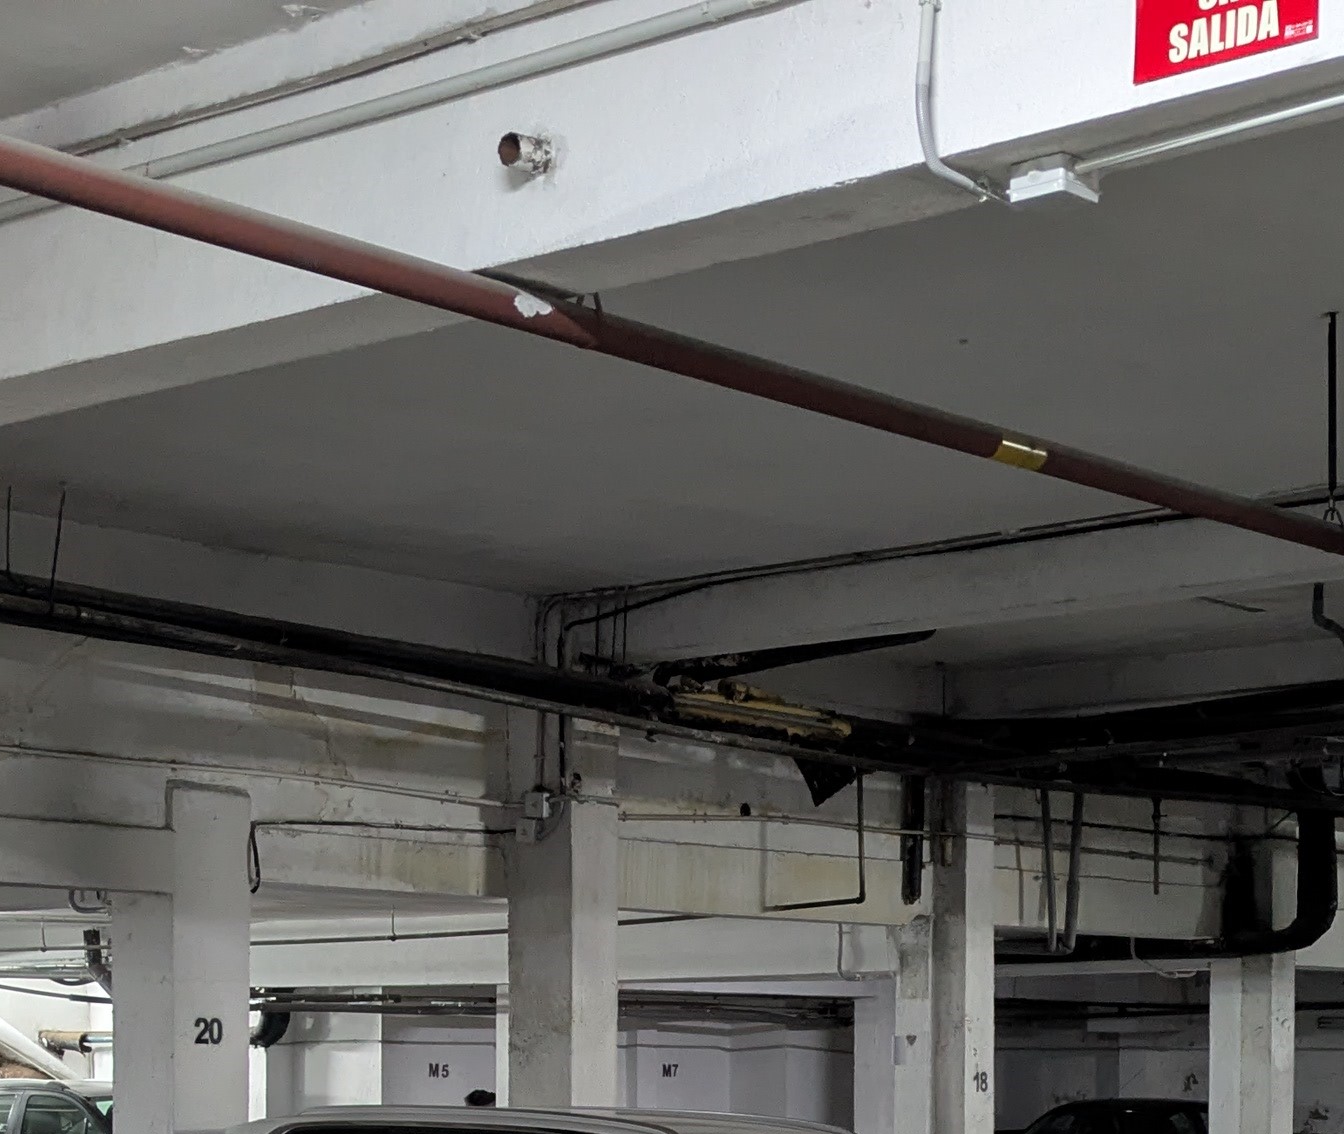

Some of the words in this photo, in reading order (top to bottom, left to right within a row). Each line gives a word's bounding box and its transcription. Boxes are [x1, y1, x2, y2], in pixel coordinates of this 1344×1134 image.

[1168, 0, 1280, 64] SALIDA
[194, 1017, 223, 1045] 20
[662, 1063, 679, 1078] M7
[973, 1071, 988, 1093] 18
